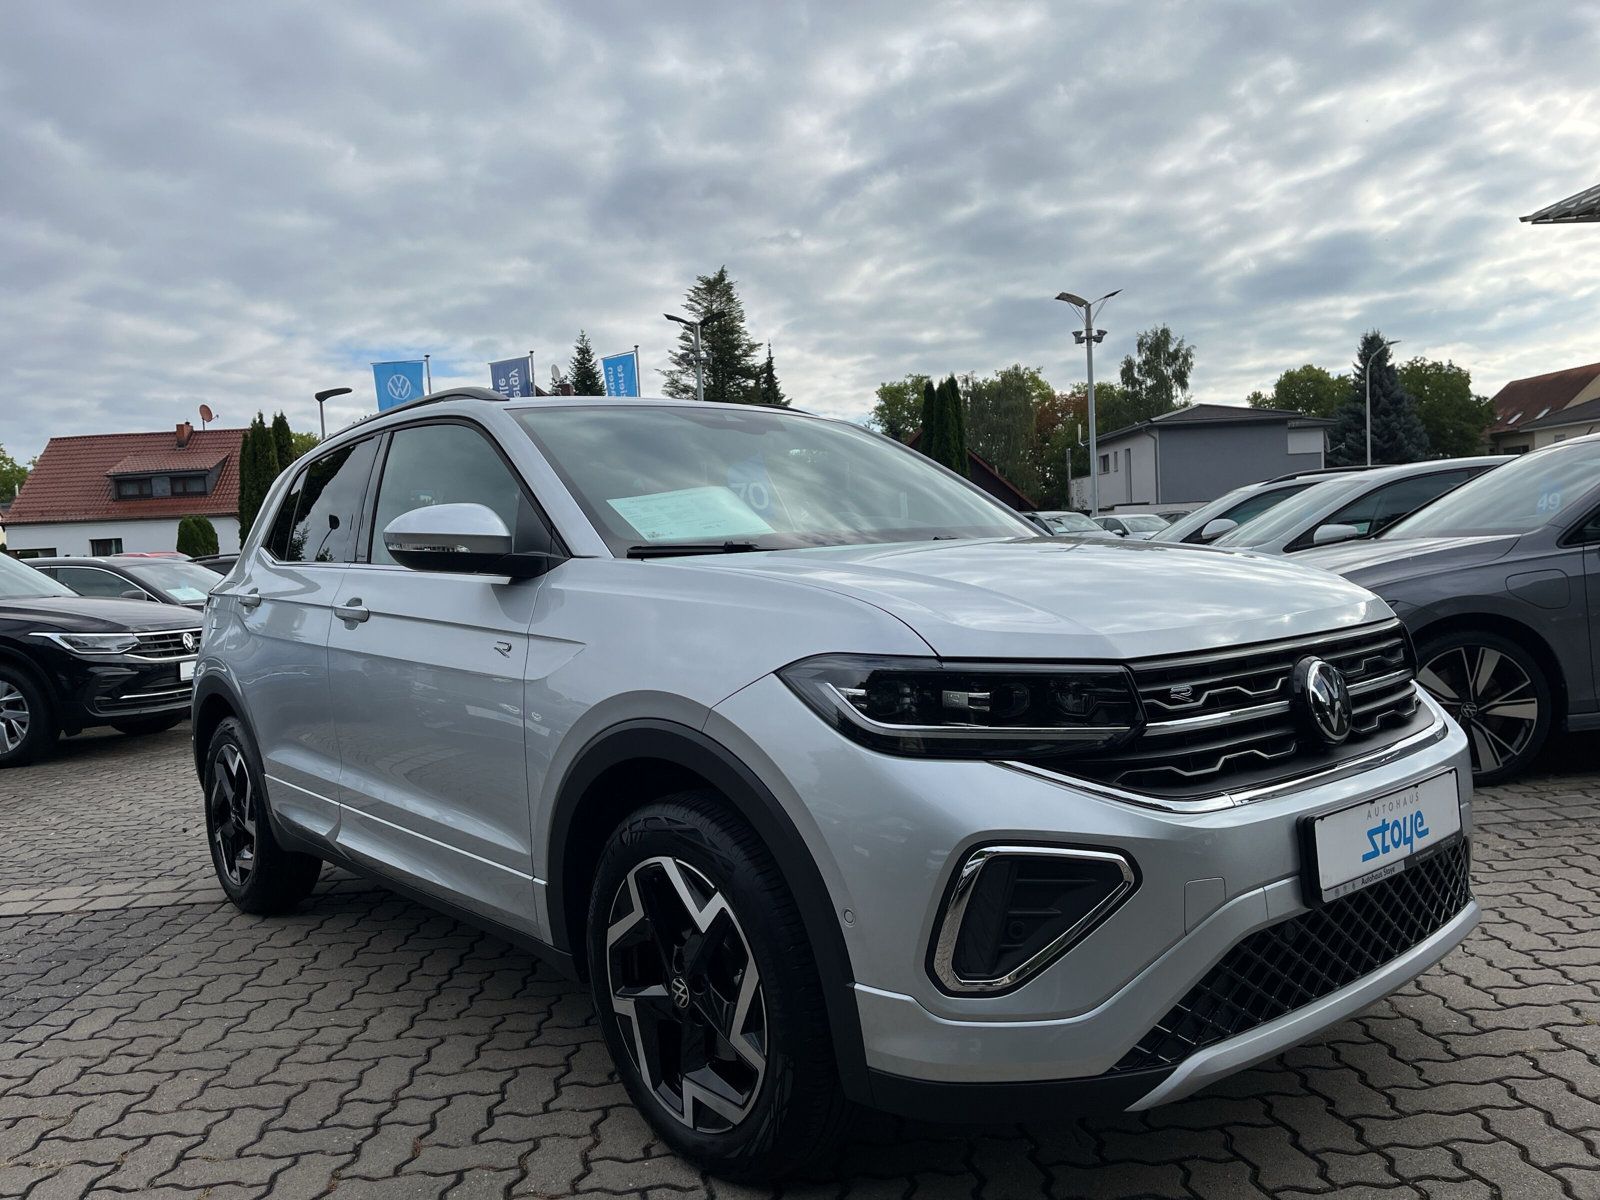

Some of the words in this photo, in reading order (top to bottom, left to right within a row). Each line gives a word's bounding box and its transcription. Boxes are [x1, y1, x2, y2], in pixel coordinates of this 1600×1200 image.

[1536, 492, 1560, 510] 49
[1366, 791, 1420, 820] AUTOHAUS
[1360, 872, 1383, 886] Autohaus
[1383, 866, 1396, 876] Stoye
